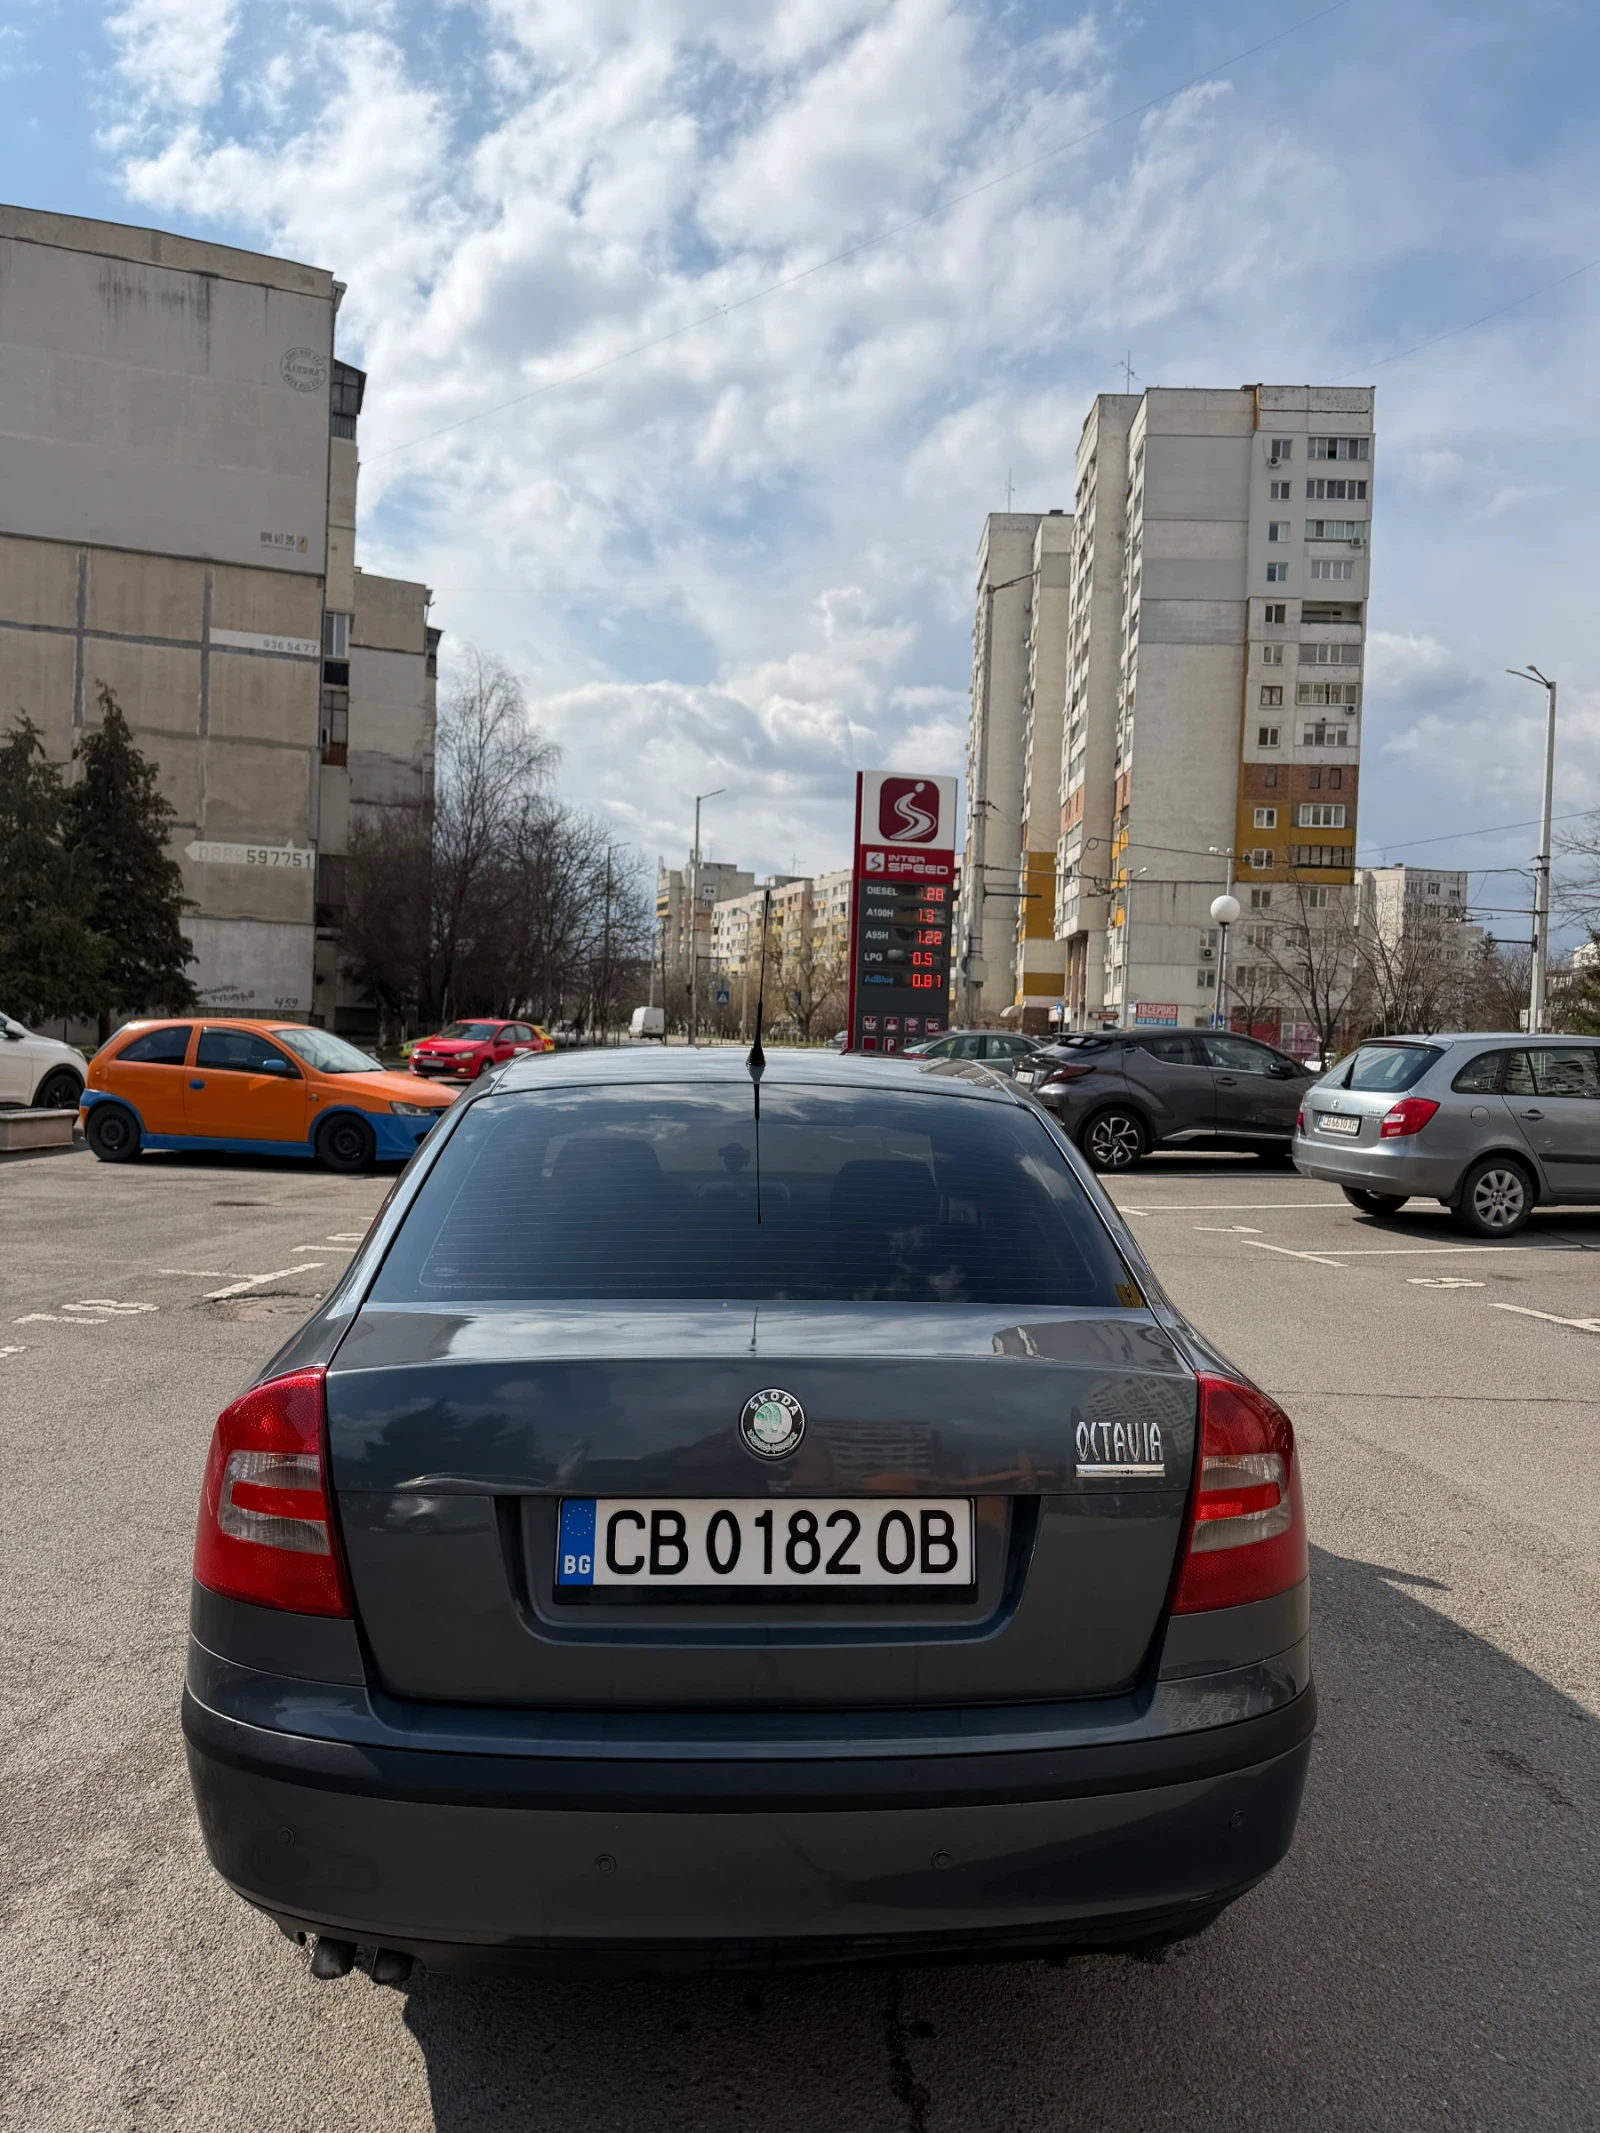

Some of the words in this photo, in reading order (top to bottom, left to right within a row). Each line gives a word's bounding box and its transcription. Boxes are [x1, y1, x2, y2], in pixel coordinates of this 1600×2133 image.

[888, 854, 925, 863] INTER
[888, 863, 949, 875] SPEED
[867, 886, 898, 896] DIESEL
[920, 887, 945, 902] 1.28
[866, 908, 893, 917] A100H
[865, 930, 889, 940] A95H
[917, 930, 943, 945] 1.22
[864, 952, 883, 961] LPG
[912, 952, 933, 966] 0.5
[864, 975, 894, 984] AdBlue
[927, 1022, 939, 1030] WC
[1075, 1421, 1164, 1462] OCTAVIA
[563, 1555, 591, 1575] BG
